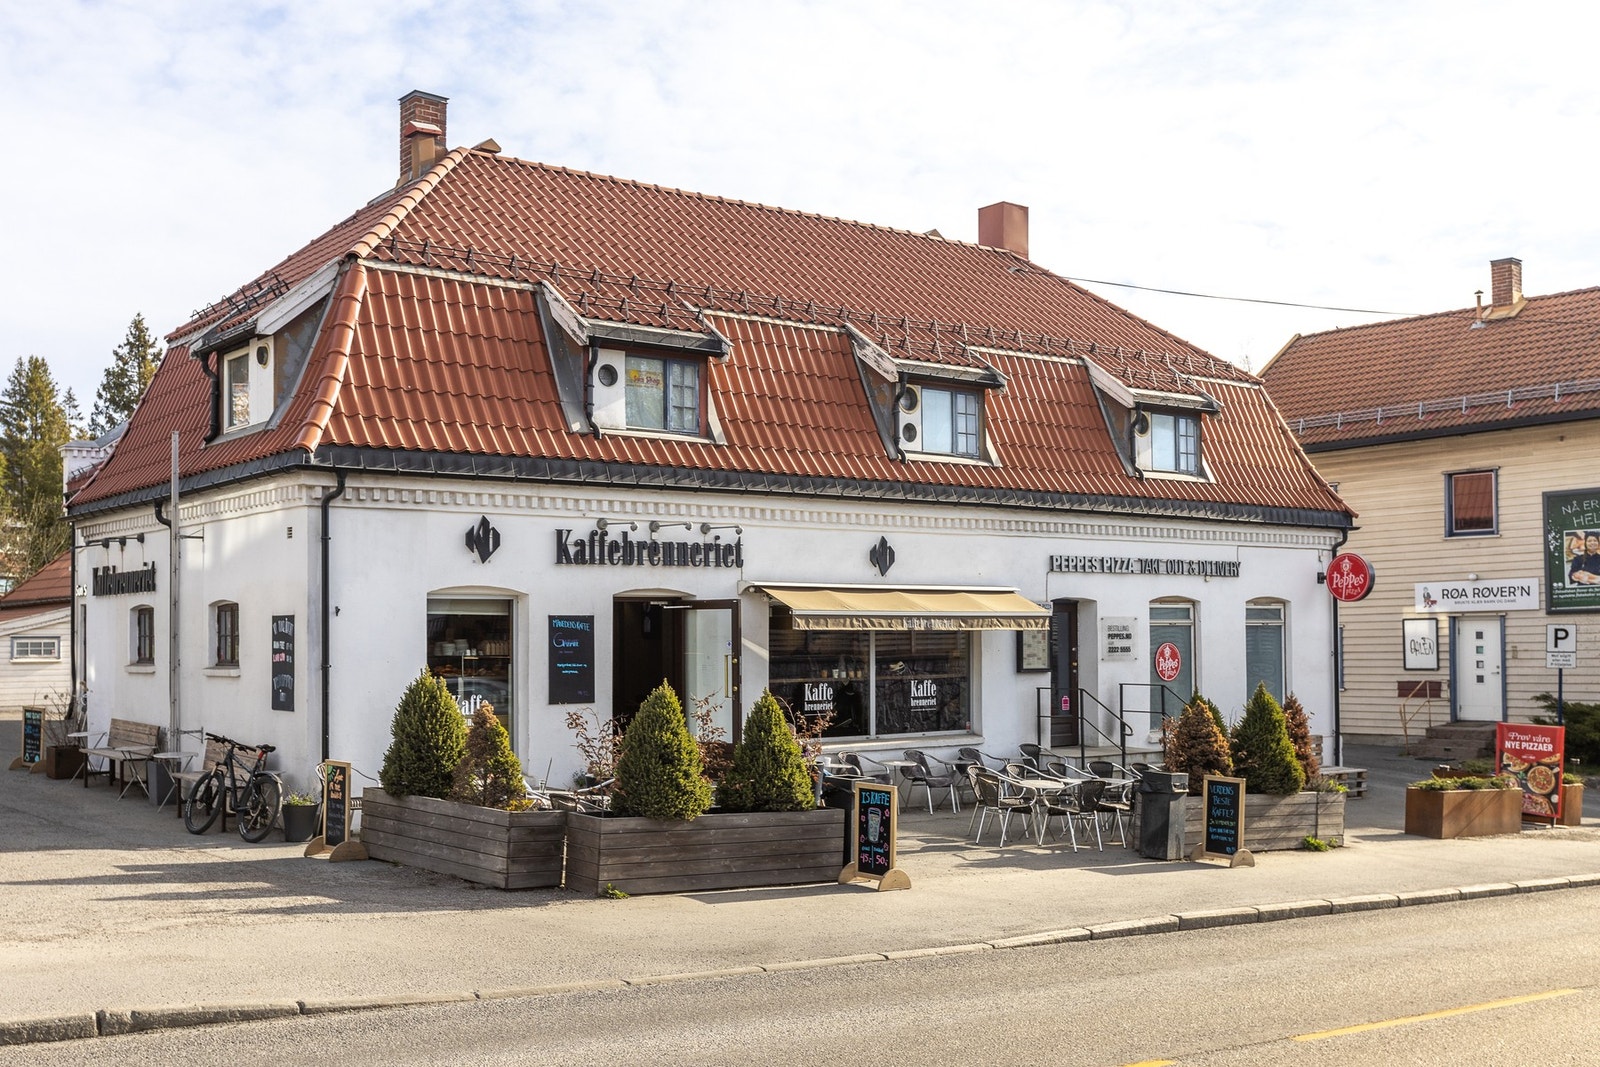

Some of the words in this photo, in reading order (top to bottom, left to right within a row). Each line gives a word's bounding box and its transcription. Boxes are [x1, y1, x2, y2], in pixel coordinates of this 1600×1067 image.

[1562, 500, 1580, 515] NÅ
[1583, 499, 1599, 511] ER
[1573, 512, 1600, 527] HEL
[554, 528, 744, 568] Kaffebrenneriet
[1050, 555, 1099, 573] PEPPES
[1101, 556, 1135, 574] PIZZA
[1166, 559, 1185, 575] OUT
[1188, 560, 1197, 575] &
[1332, 571, 1365, 588] Peppes
[1441, 588, 1469, 599] RØA
[1554, 628, 1569, 648] P
[1159, 657, 1179, 670] Peppes
[804, 683, 834, 701] Kaffe
[911, 680, 937, 697] Kaffe
[451, 694, 489, 716] aff
[804, 701, 833, 711] brenneriet
[911, 697, 937, 706] brenneriet
[1505, 740, 1521, 749] NYE
[1521, 742, 1554, 752] PIZZAER
[1210, 785, 1234, 795] VERDENS
[1213, 795, 1231, 805] BESTE
[1211, 806, 1234, 818] KAFFE?
